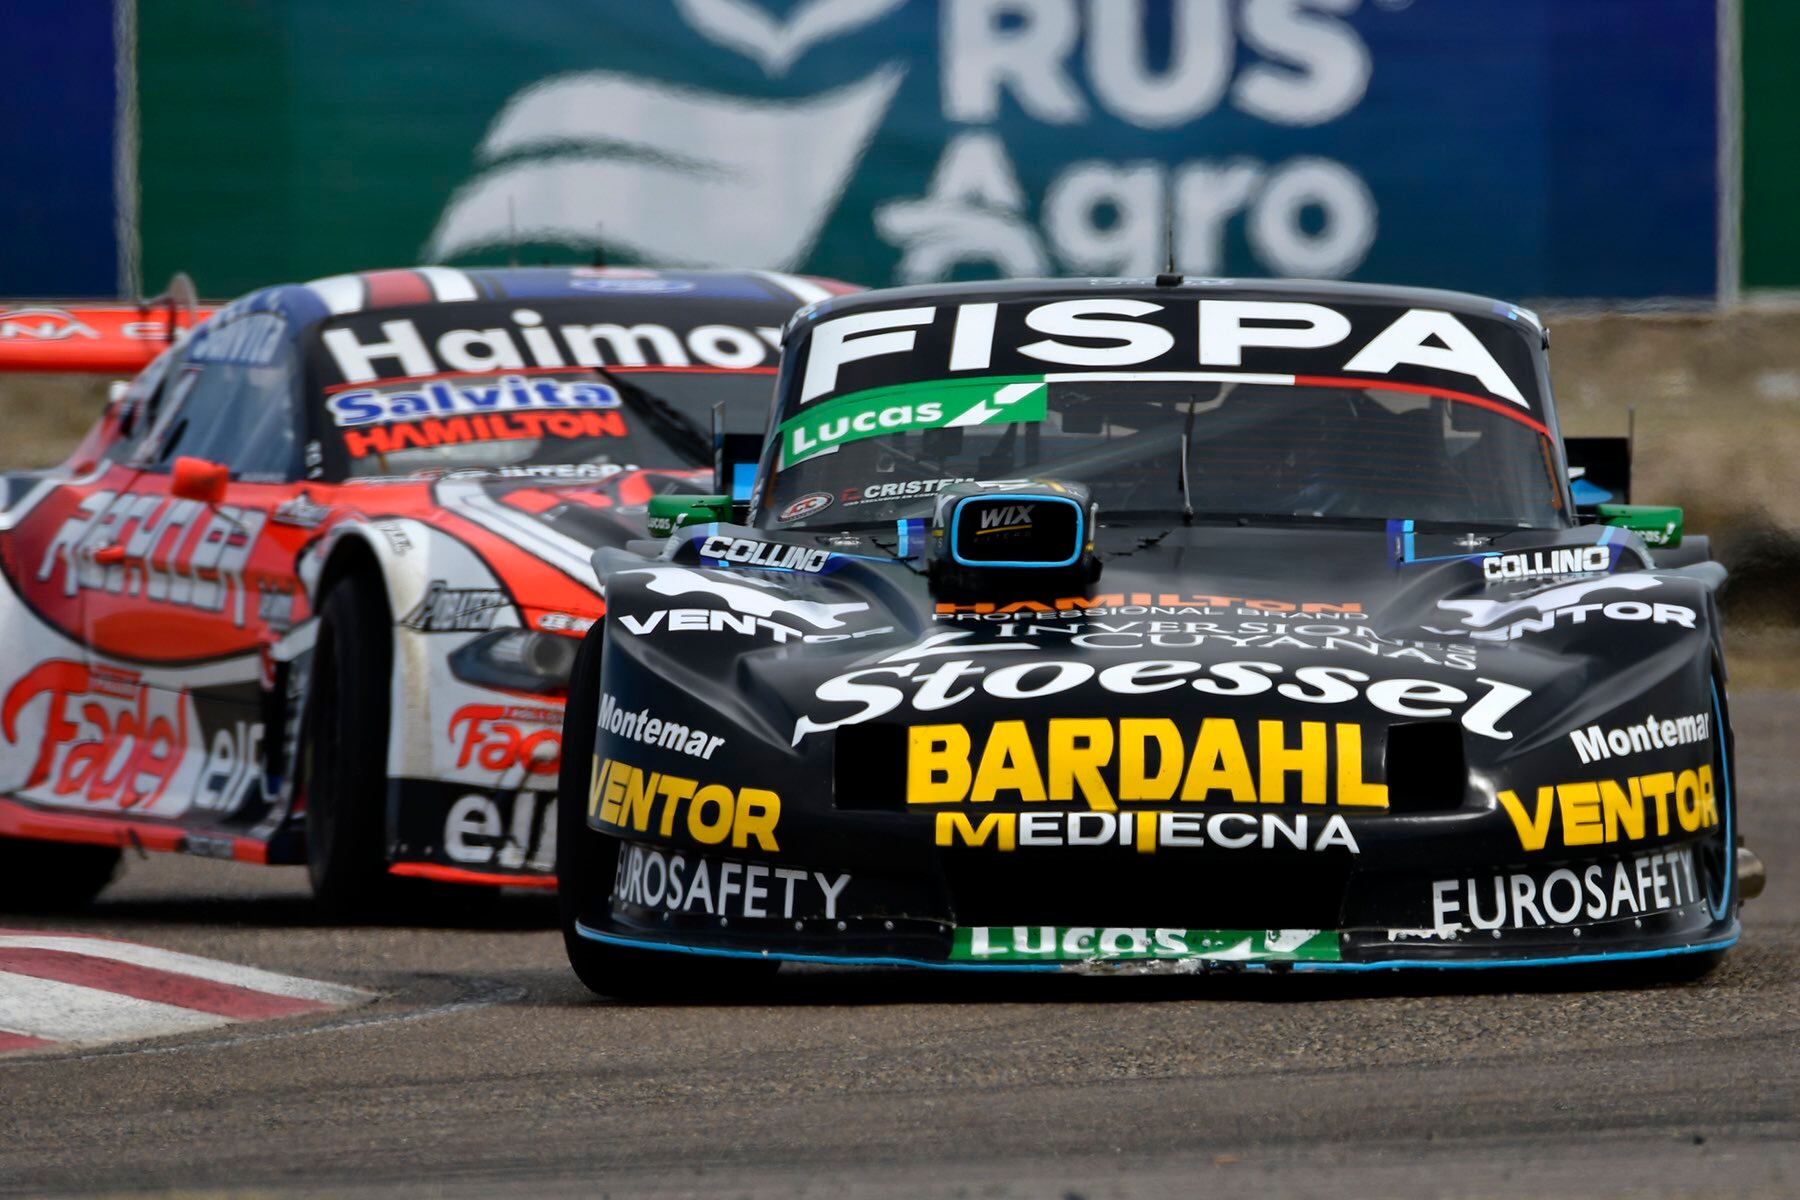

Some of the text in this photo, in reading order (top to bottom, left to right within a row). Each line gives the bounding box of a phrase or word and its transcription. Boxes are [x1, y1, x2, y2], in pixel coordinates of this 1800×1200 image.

[940, 0, 1373, 127] RUS
[877, 132, 1378, 280] Agro
[800, 299, 1531, 410] FISPA
[328, 376, 622, 427] Salvita
[792, 401, 944, 456] Lucas
[343, 410, 628, 459] HAMILTON
[980, 504, 1036, 529] WIX
[700, 536, 832, 573] COLLINO
[1482, 546, 1610, 580] COLLINO
[935, 592, 1363, 614] HAMILTON
[1071, 632, 1477, 671] CUYANAS
[597, 692, 726, 761] Montemar
[791, 657, 1533, 748] Stoessel
[907, 717, 1390, 811] BARDAHL
[1569, 711, 1710, 765] Montemar
[587, 752, 781, 852] VENTOR
[1497, 763, 1719, 852] VENTOR
[1432, 847, 1697, 932] EUROSAFETY
